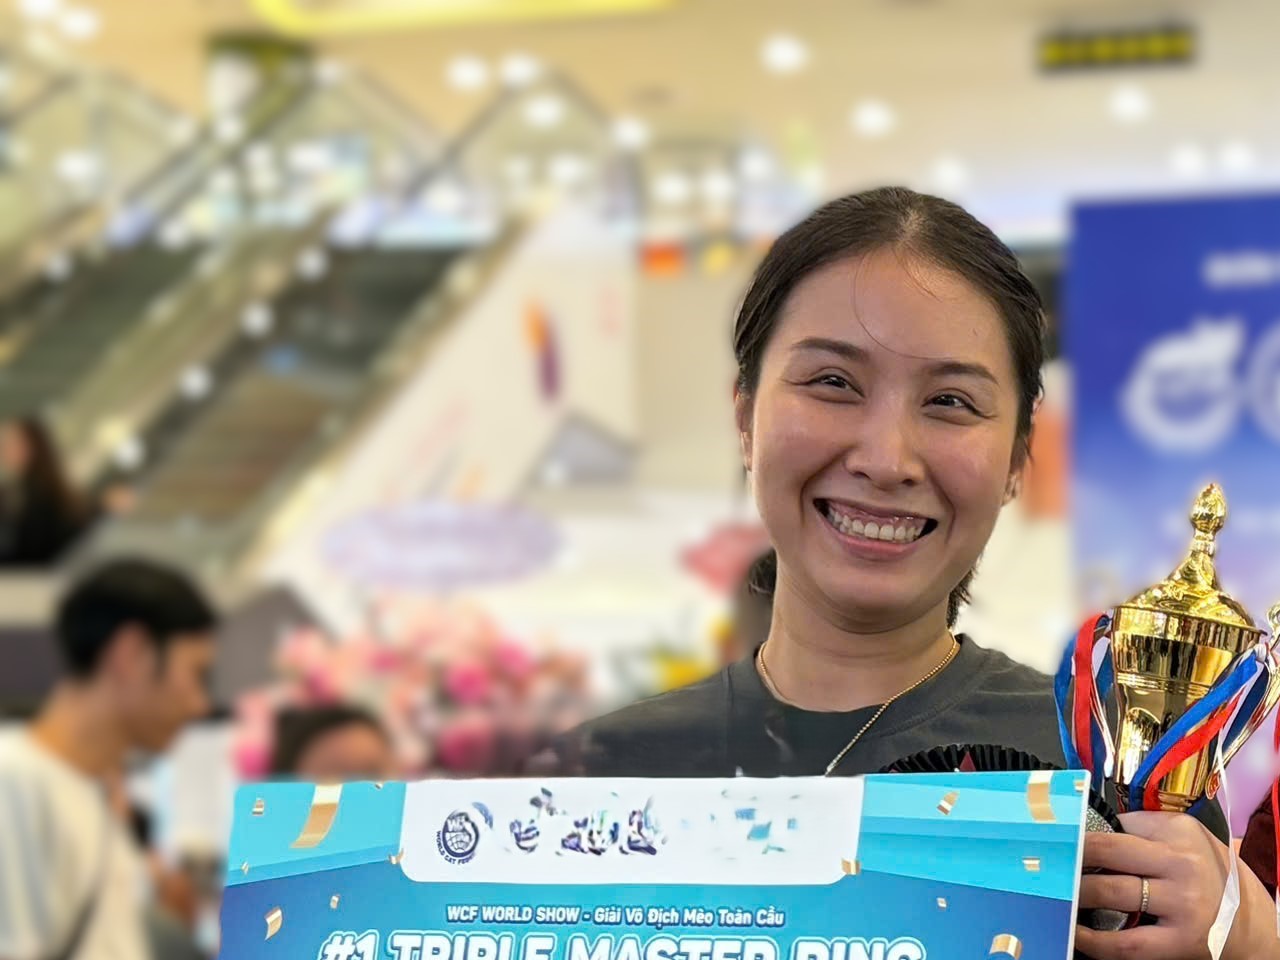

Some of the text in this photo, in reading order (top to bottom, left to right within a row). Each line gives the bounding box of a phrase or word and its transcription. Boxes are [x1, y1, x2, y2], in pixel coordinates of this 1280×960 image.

[446, 904, 479, 923] WCF
[481, 904, 533, 924] WORLD
[535, 905, 580, 924] SHOW
[647, 907, 679, 930] Địch
[683, 907, 715, 927] Mèo
[718, 908, 751, 928] Toàn
[756, 905, 785, 928] Cầu
